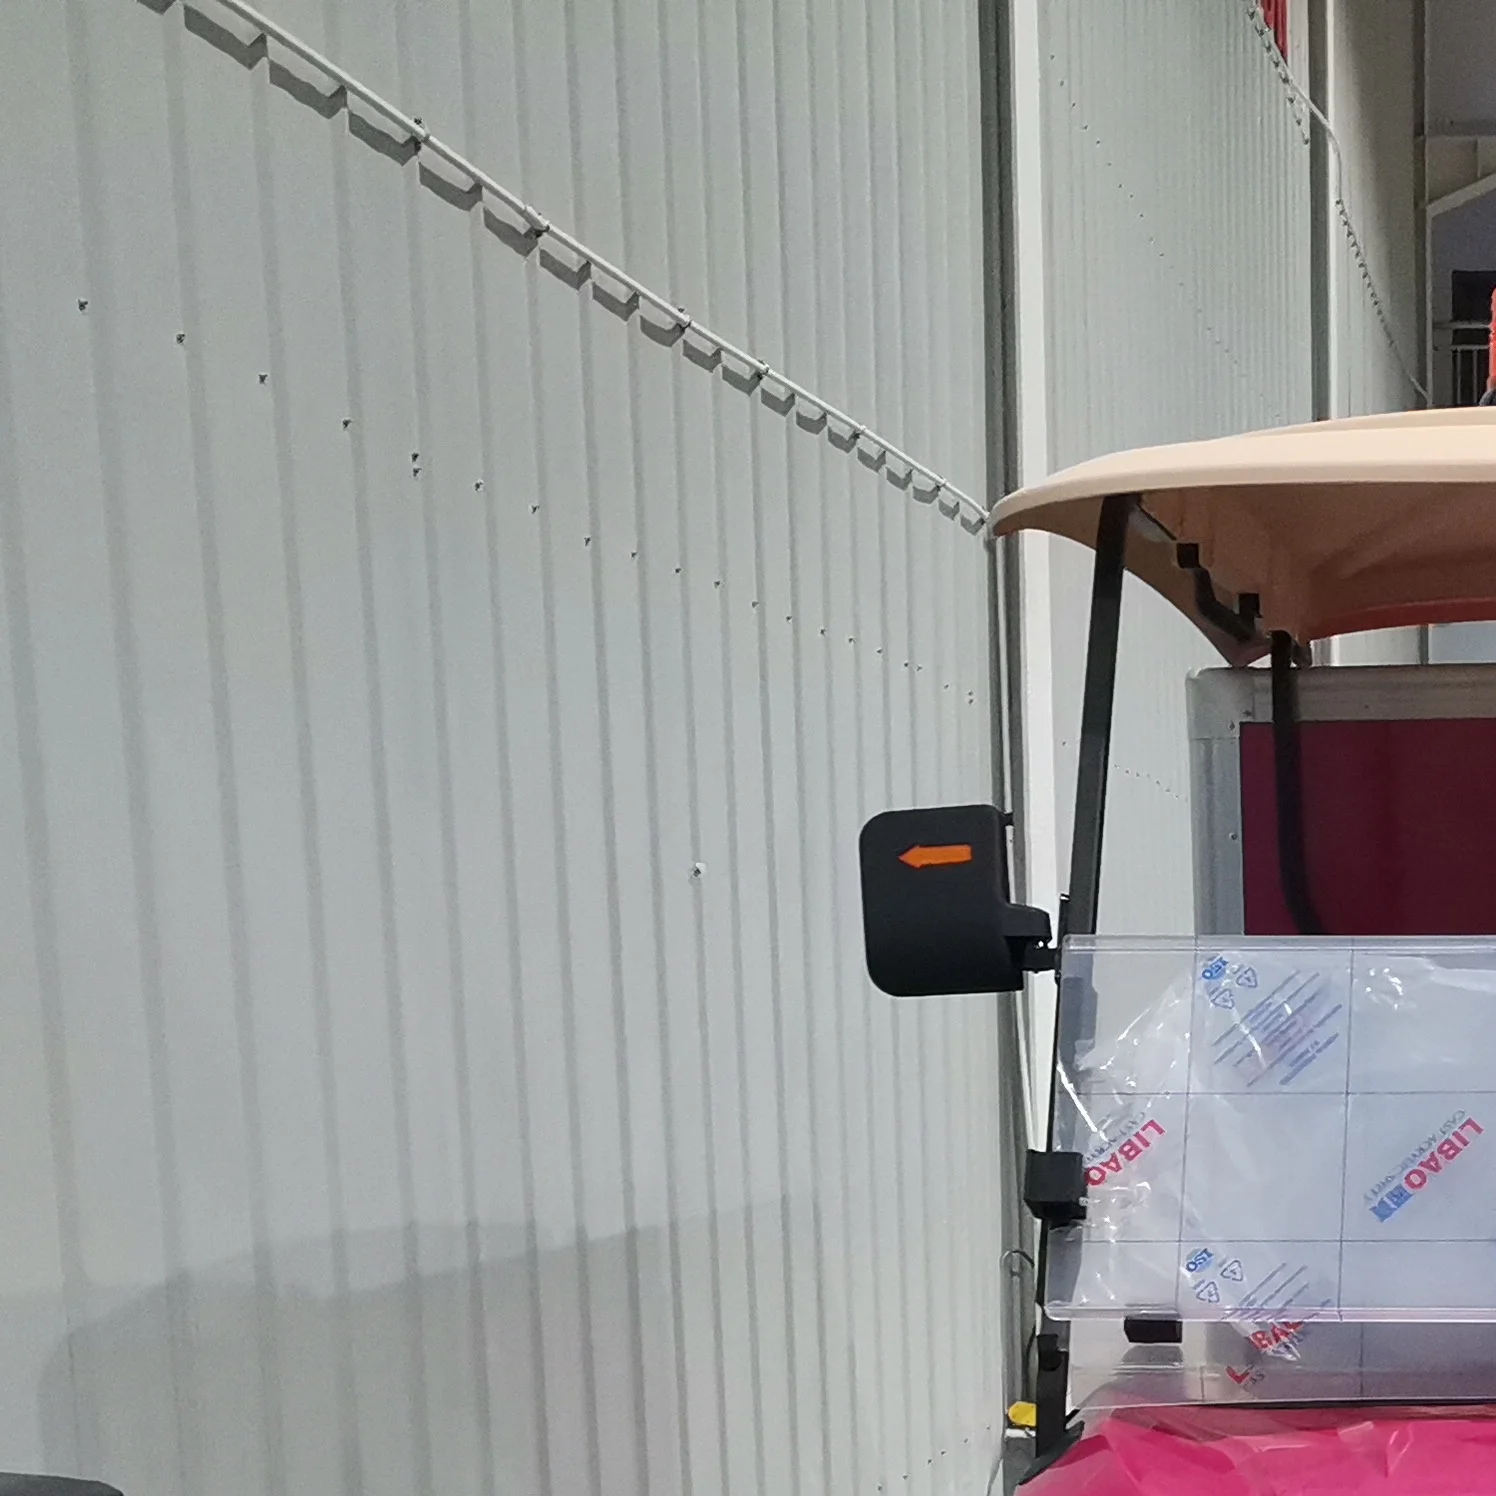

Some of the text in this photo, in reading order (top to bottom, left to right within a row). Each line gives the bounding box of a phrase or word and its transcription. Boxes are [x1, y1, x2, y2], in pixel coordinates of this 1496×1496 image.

[1202, 957, 1228, 979] ISO
[1084, 1119, 1165, 1186] LIBAO
[1404, 1117, 1484, 1190] LIBAO
[1186, 1249, 1213, 1272] ISO
